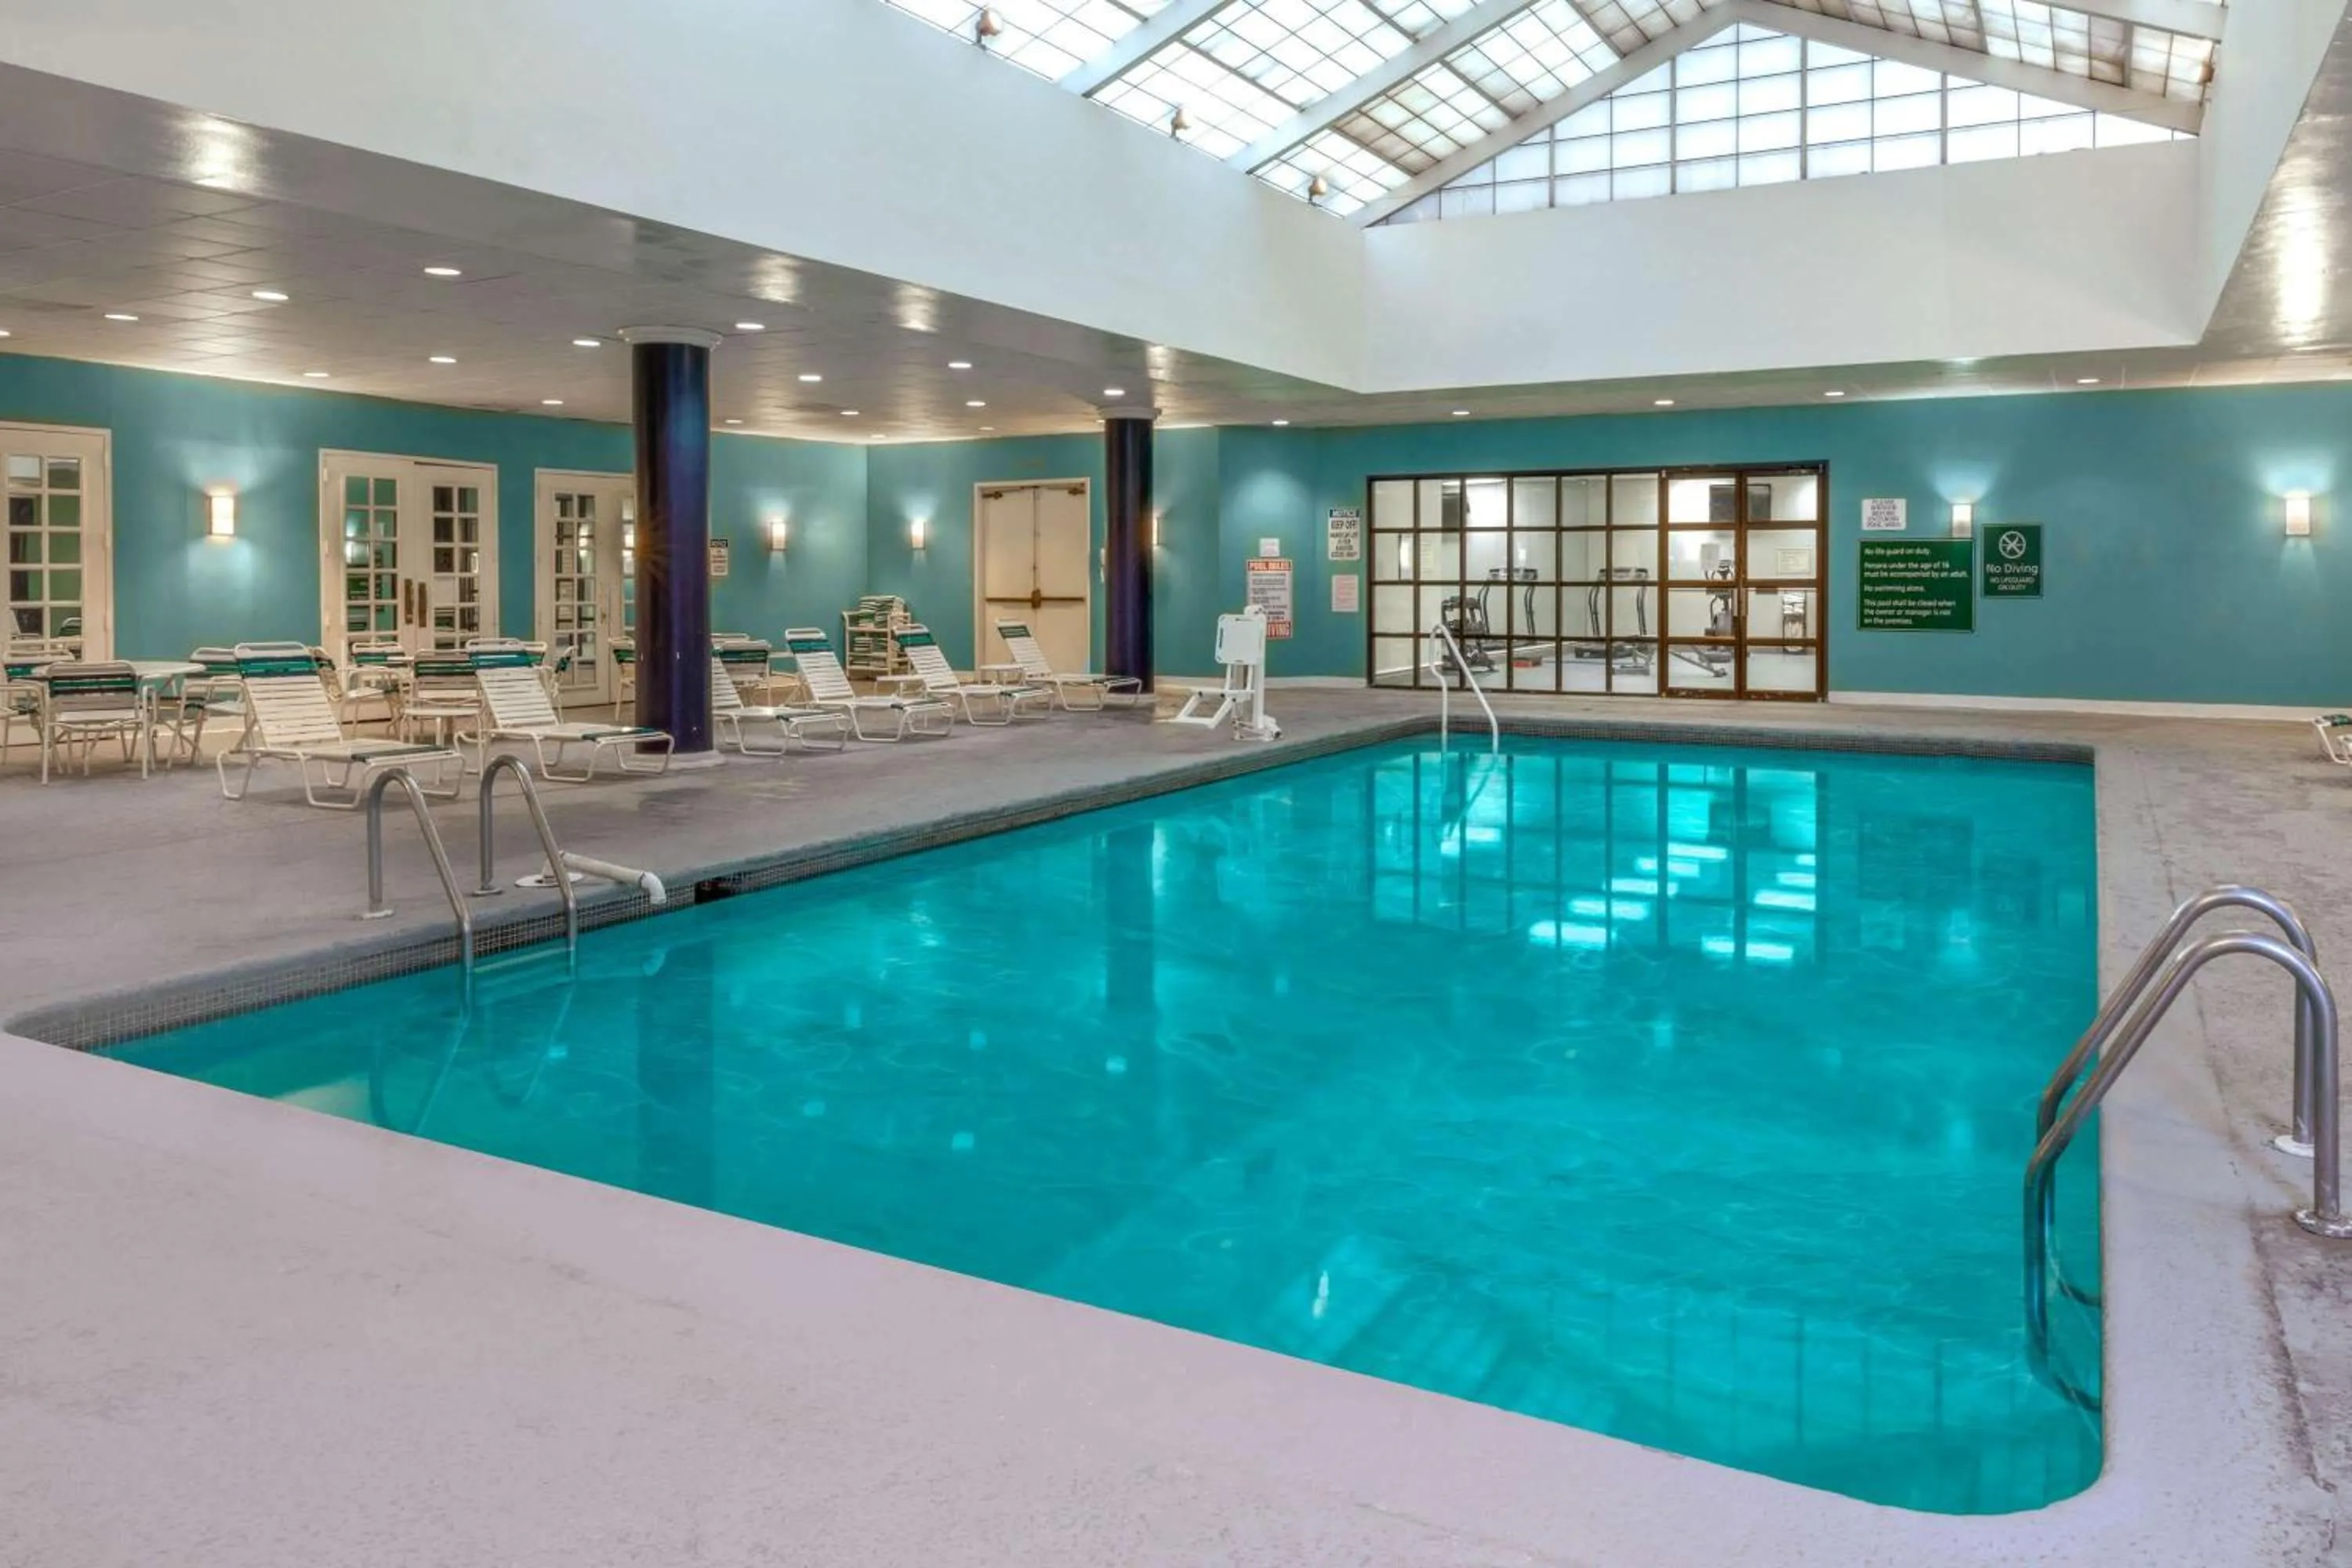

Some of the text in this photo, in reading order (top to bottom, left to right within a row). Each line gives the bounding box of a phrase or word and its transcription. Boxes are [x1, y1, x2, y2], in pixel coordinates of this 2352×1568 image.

[1886, 548, 1904, 557] guard
[1986, 562, 2038, 576] No Diving
[1864, 598, 1875, 607] This
[1877, 599, 1891, 608] pool
[1904, 609, 1932, 618] manager
[1267, 622, 1290, 636] IVING
